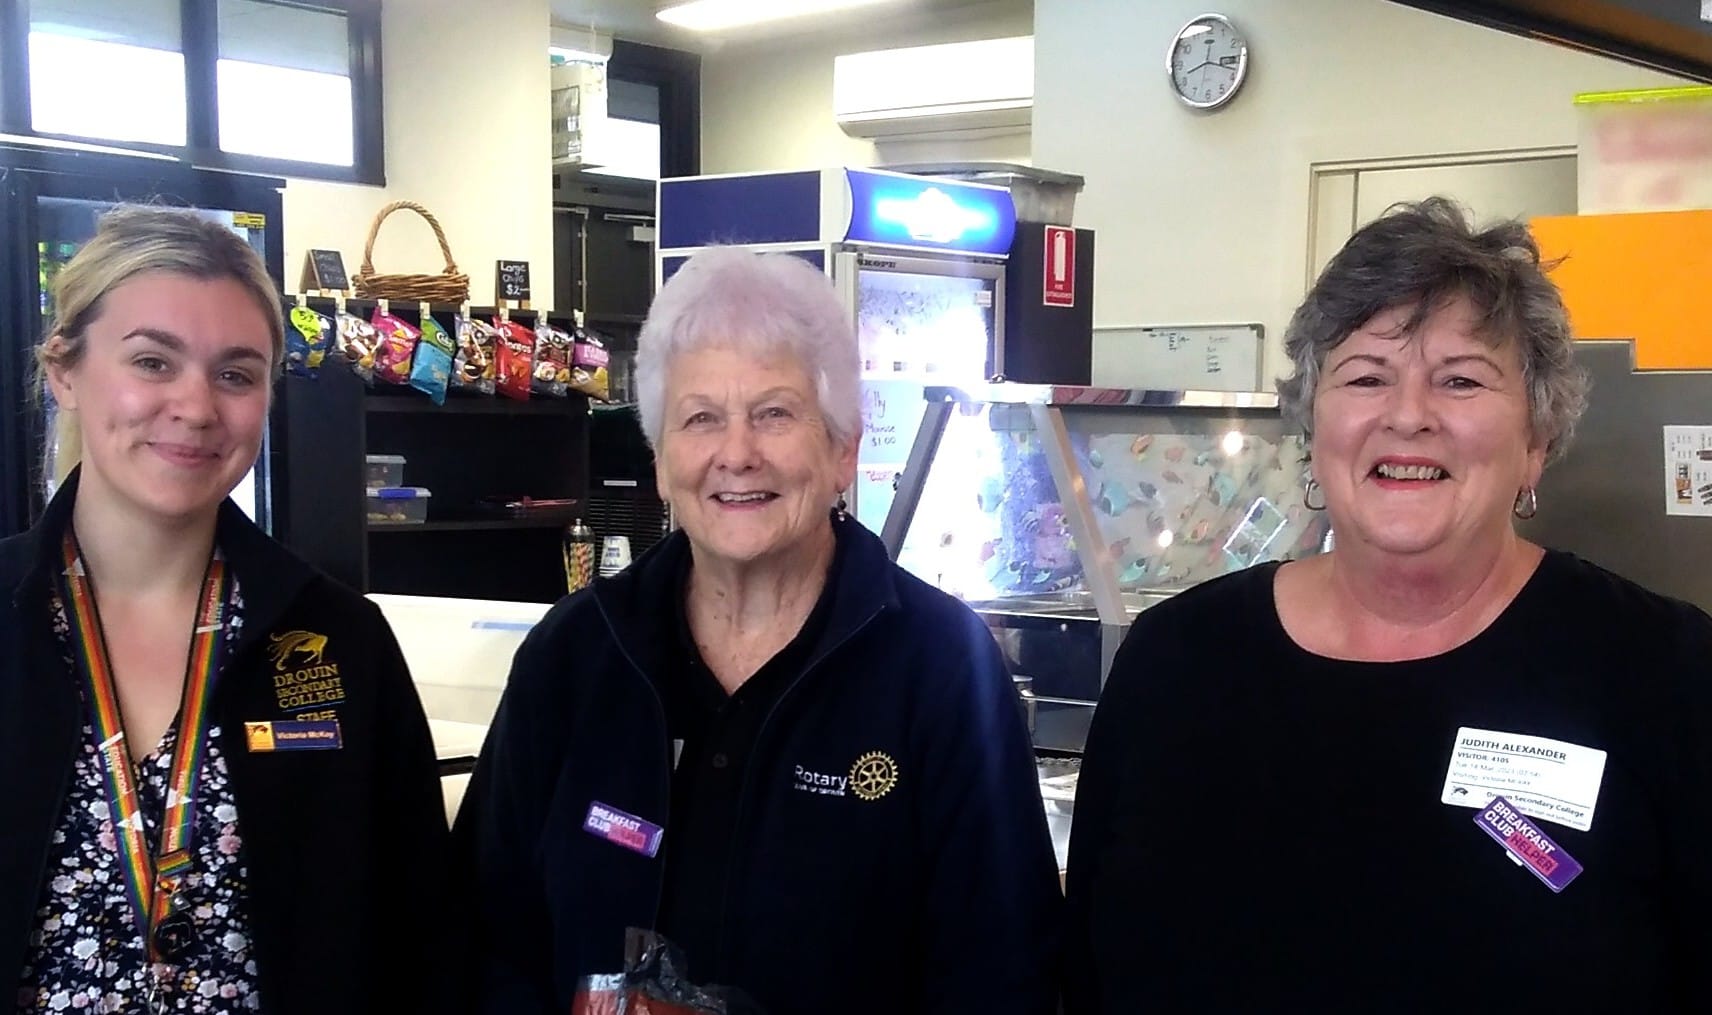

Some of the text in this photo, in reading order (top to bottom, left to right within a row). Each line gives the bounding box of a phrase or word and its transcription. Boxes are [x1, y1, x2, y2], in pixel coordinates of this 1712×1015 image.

[1230, 38, 1236, 49] 2
[1192, 87, 1198, 97] 7
[1205, 88, 1211, 99] 6
[1219, 84, 1225, 95] 5
[273, 664, 339, 688] DROUIN
[278, 688, 346, 709] COLLEGE
[1460, 738, 1567, 762] JUDITH ALEXANDER
[795, 764, 848, 791] Rotary
[1514, 794, 1554, 811] Secondary
[1555, 804, 1585, 818] College
[588, 816, 611, 833] CLUB
[591, 805, 641, 832] BREAKFAST
[1492, 801, 1555, 854] BREAKFAST
[1484, 810, 1515, 837] CLUB
[1510, 833, 1554, 872] HELPER
